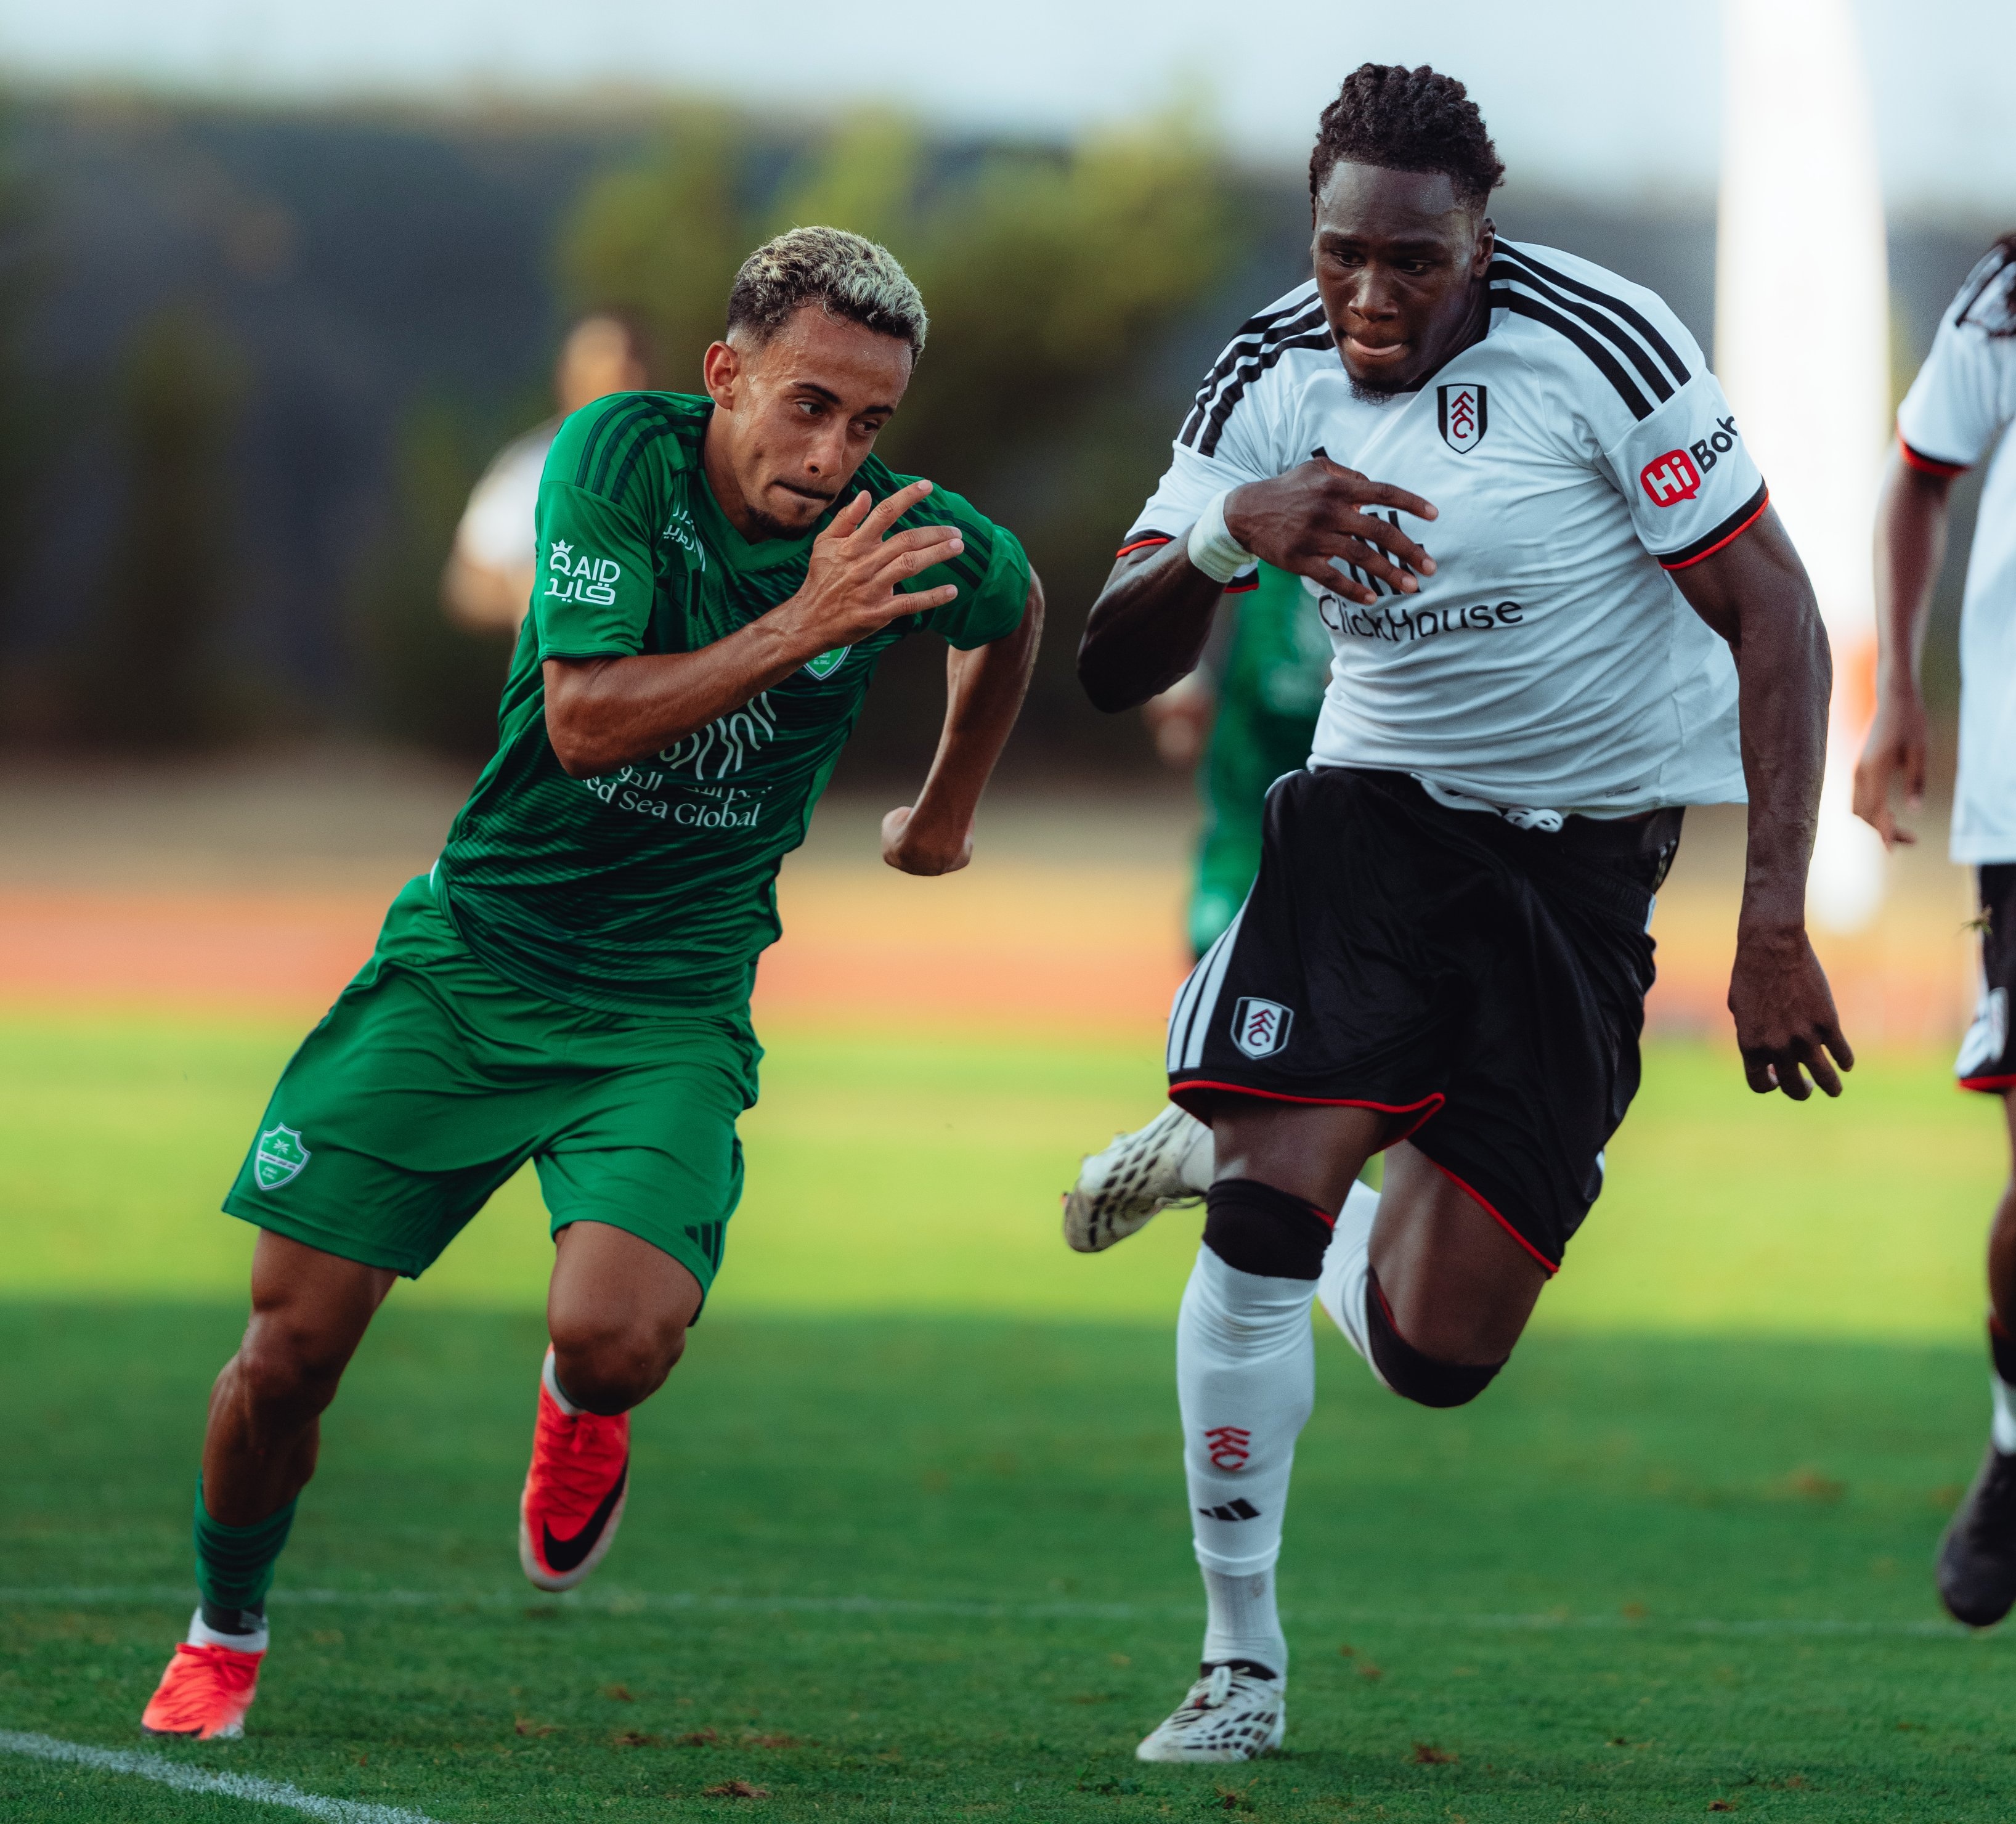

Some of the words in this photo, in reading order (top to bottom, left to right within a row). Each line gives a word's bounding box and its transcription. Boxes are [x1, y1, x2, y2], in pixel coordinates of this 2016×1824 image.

[1450, 391, 1475, 439] FFC
[550, 551, 620, 583] QAID
[1318, 600, 1524, 641] ClickHouse
[582, 775, 617, 804] ed
[619, 790, 669, 820] Sea
[674, 802, 762, 828] Global
